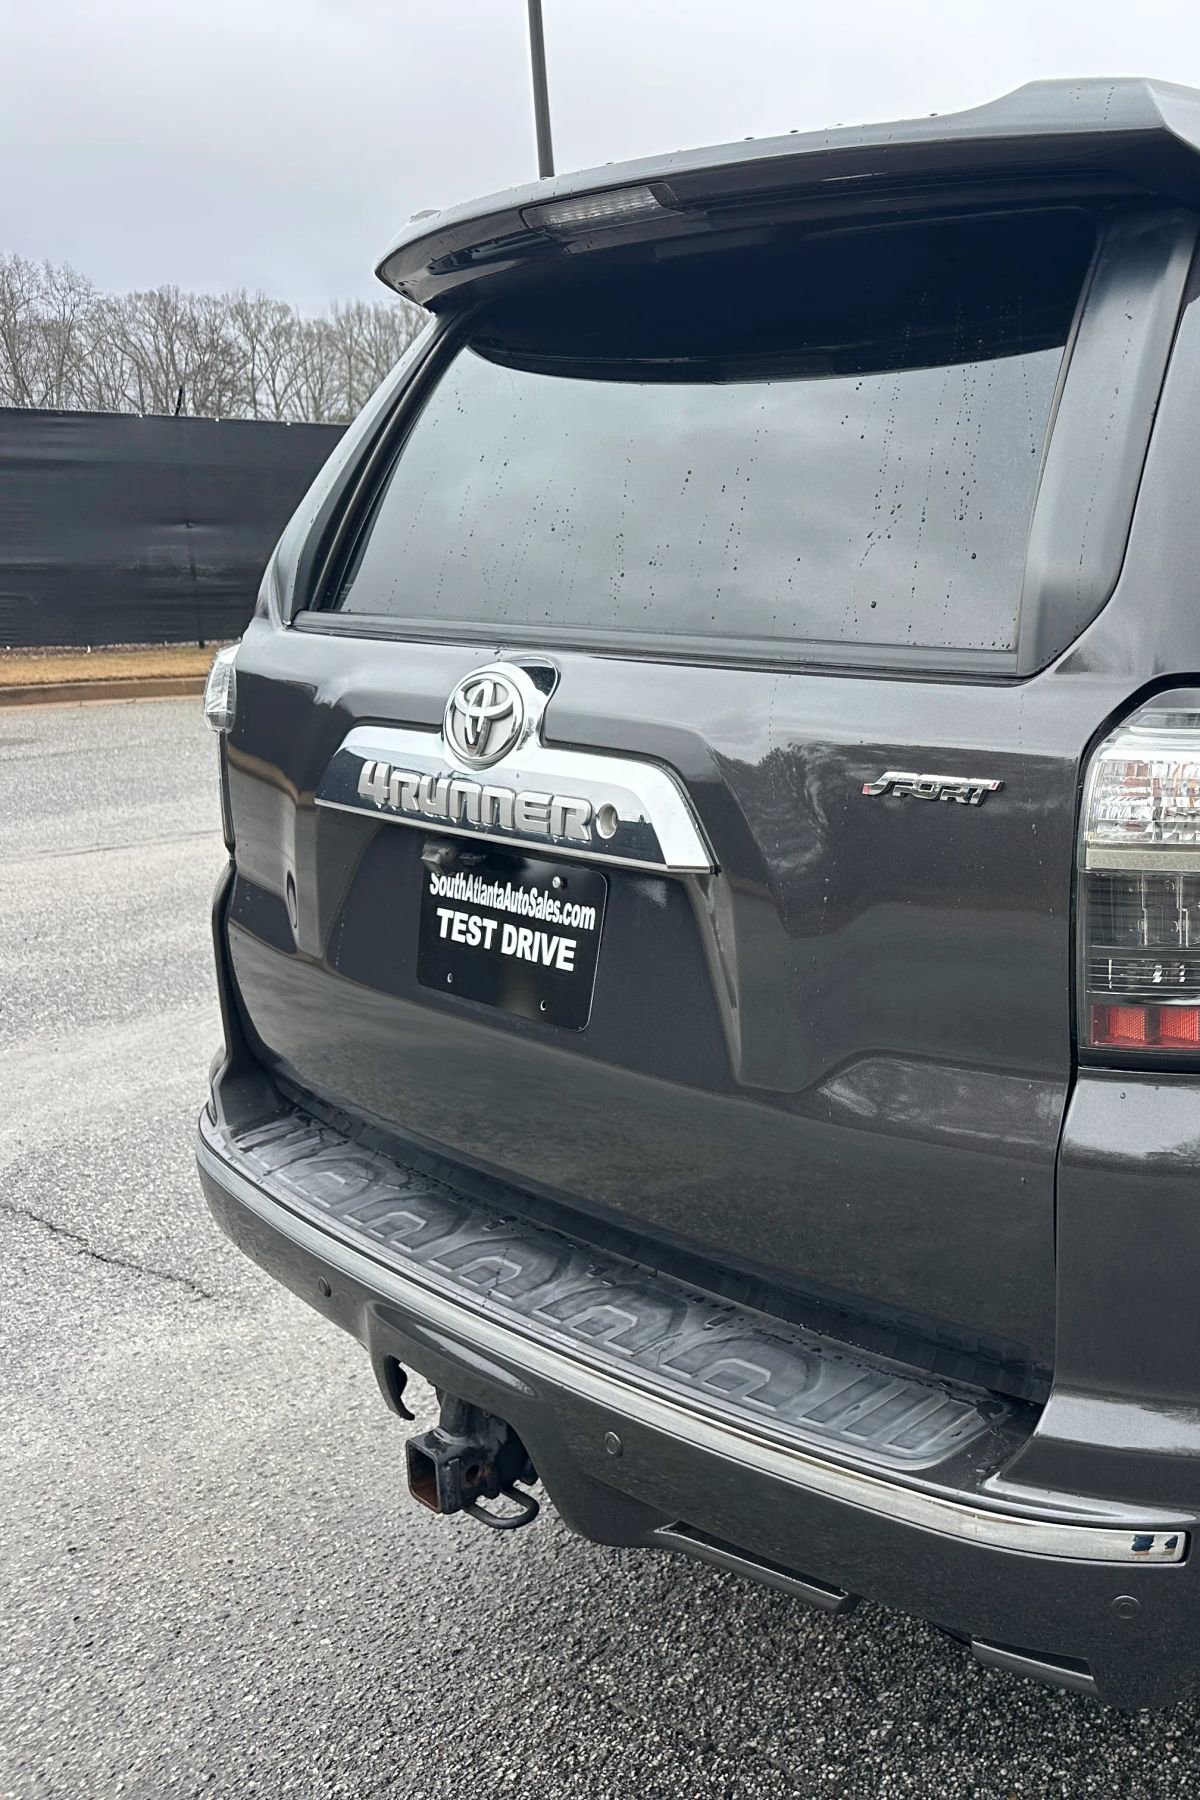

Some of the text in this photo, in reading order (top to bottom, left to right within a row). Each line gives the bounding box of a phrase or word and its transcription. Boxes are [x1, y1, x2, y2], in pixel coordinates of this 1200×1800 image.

[357, 760, 593, 841] 4RUNNER
[862, 771, 1003, 806] SPORT
[429, 873, 596, 931] SouthAtlantaAutoSales.com
[436, 908, 577, 972] TEST DRIVE
